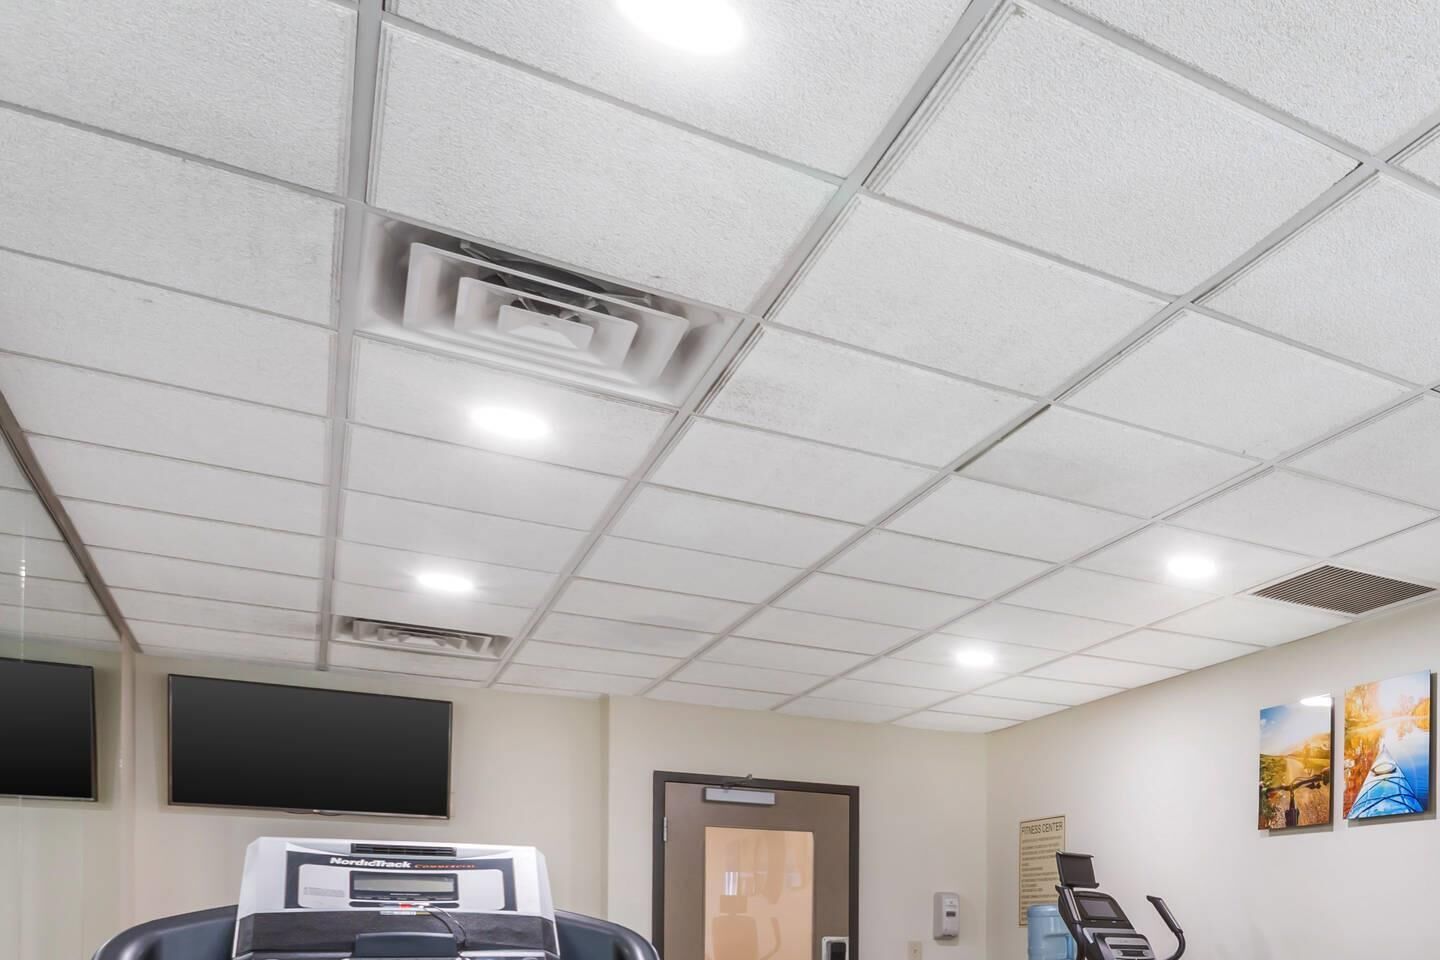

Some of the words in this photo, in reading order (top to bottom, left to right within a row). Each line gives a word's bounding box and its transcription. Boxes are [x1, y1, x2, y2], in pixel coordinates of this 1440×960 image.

[1021, 823, 1042, 835] FITNESS
[1042, 820, 1064, 834] CENTER
[329, 856, 412, 869] NordicTrack
